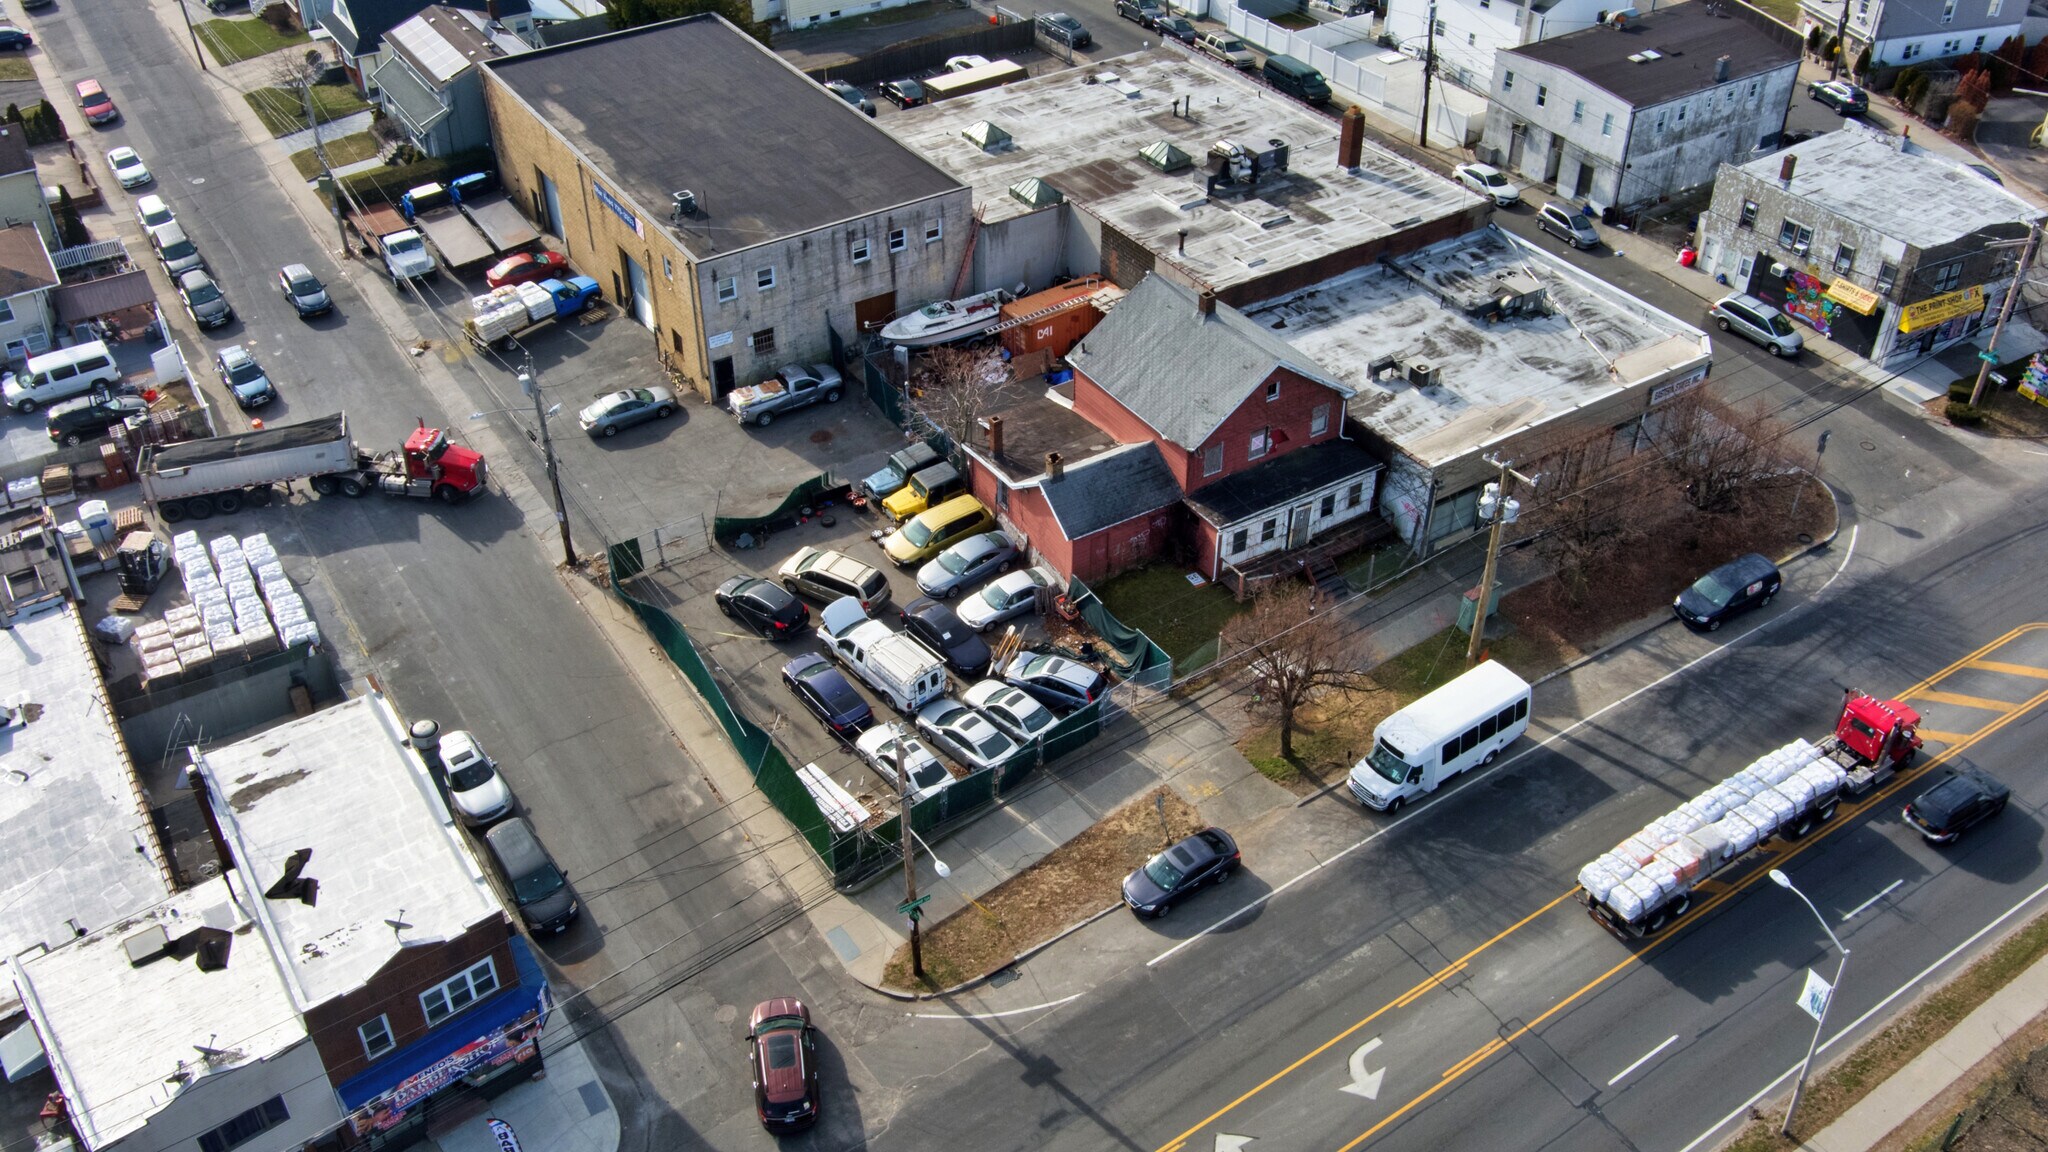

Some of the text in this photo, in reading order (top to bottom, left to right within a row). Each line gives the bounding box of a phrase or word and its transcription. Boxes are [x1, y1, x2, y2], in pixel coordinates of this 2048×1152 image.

[1916, 304, 1928, 314] THE
[1929, 299, 1946, 311] PRINT
[1947, 294, 1962, 305] SHOP
[1963, 287, 1980, 301] GFX
